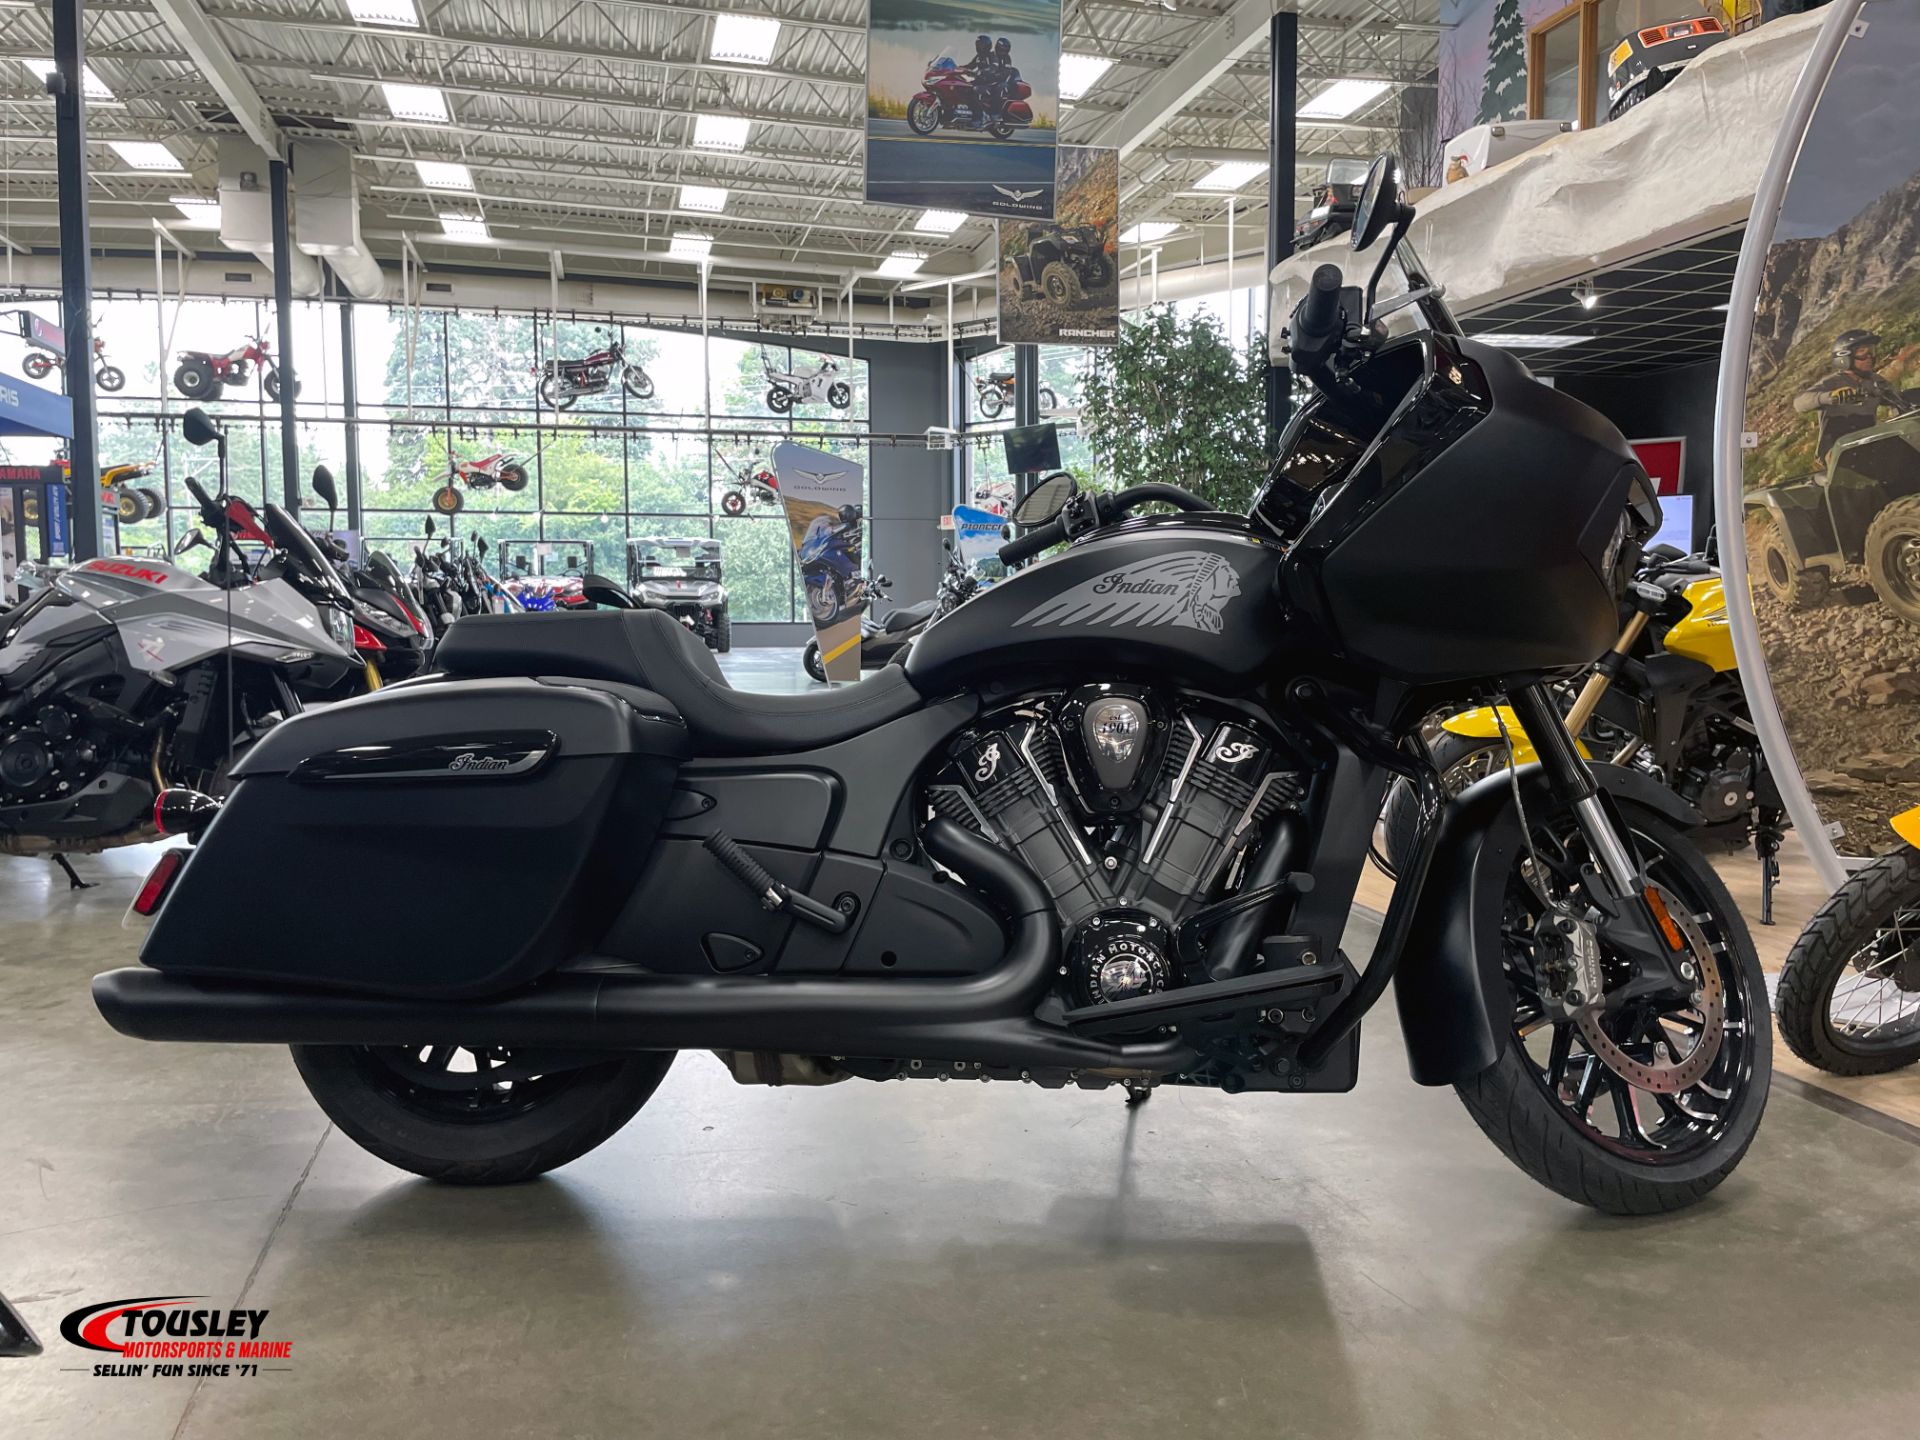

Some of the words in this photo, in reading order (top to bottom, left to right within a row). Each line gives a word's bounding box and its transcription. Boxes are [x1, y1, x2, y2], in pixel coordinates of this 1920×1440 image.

[1059, 328, 1116, 338] RANCHER
[87, 561, 168, 584] SUZUKI
[1093, 573, 1179, 596] Indian
[448, 752, 510, 771] Indian
[1108, 942, 1165, 993] MOTORCYC
